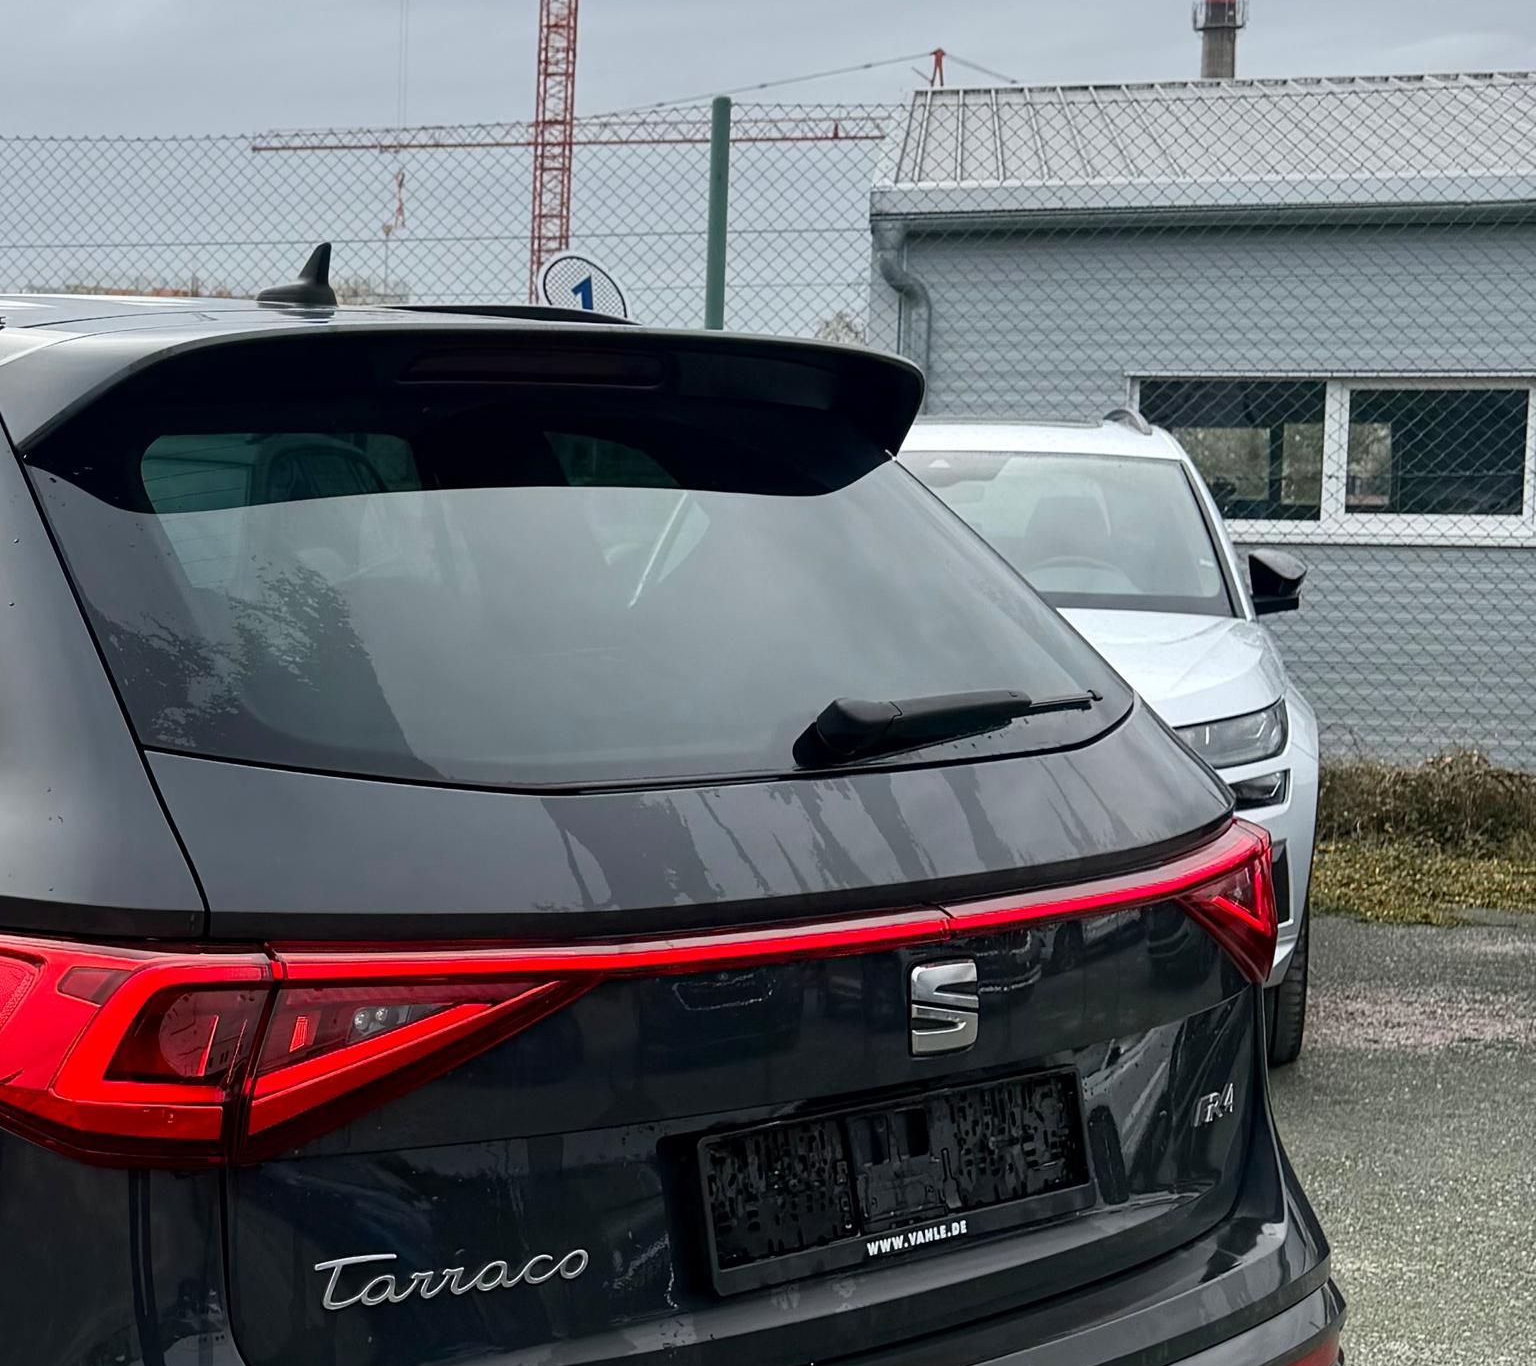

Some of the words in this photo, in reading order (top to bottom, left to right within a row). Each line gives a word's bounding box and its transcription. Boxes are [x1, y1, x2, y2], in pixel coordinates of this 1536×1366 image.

[571, 274, 594, 311] 1
[866, 1219, 968, 1257] WWW.VAHLE.DE
[314, 1248, 590, 1312] Tarraco
